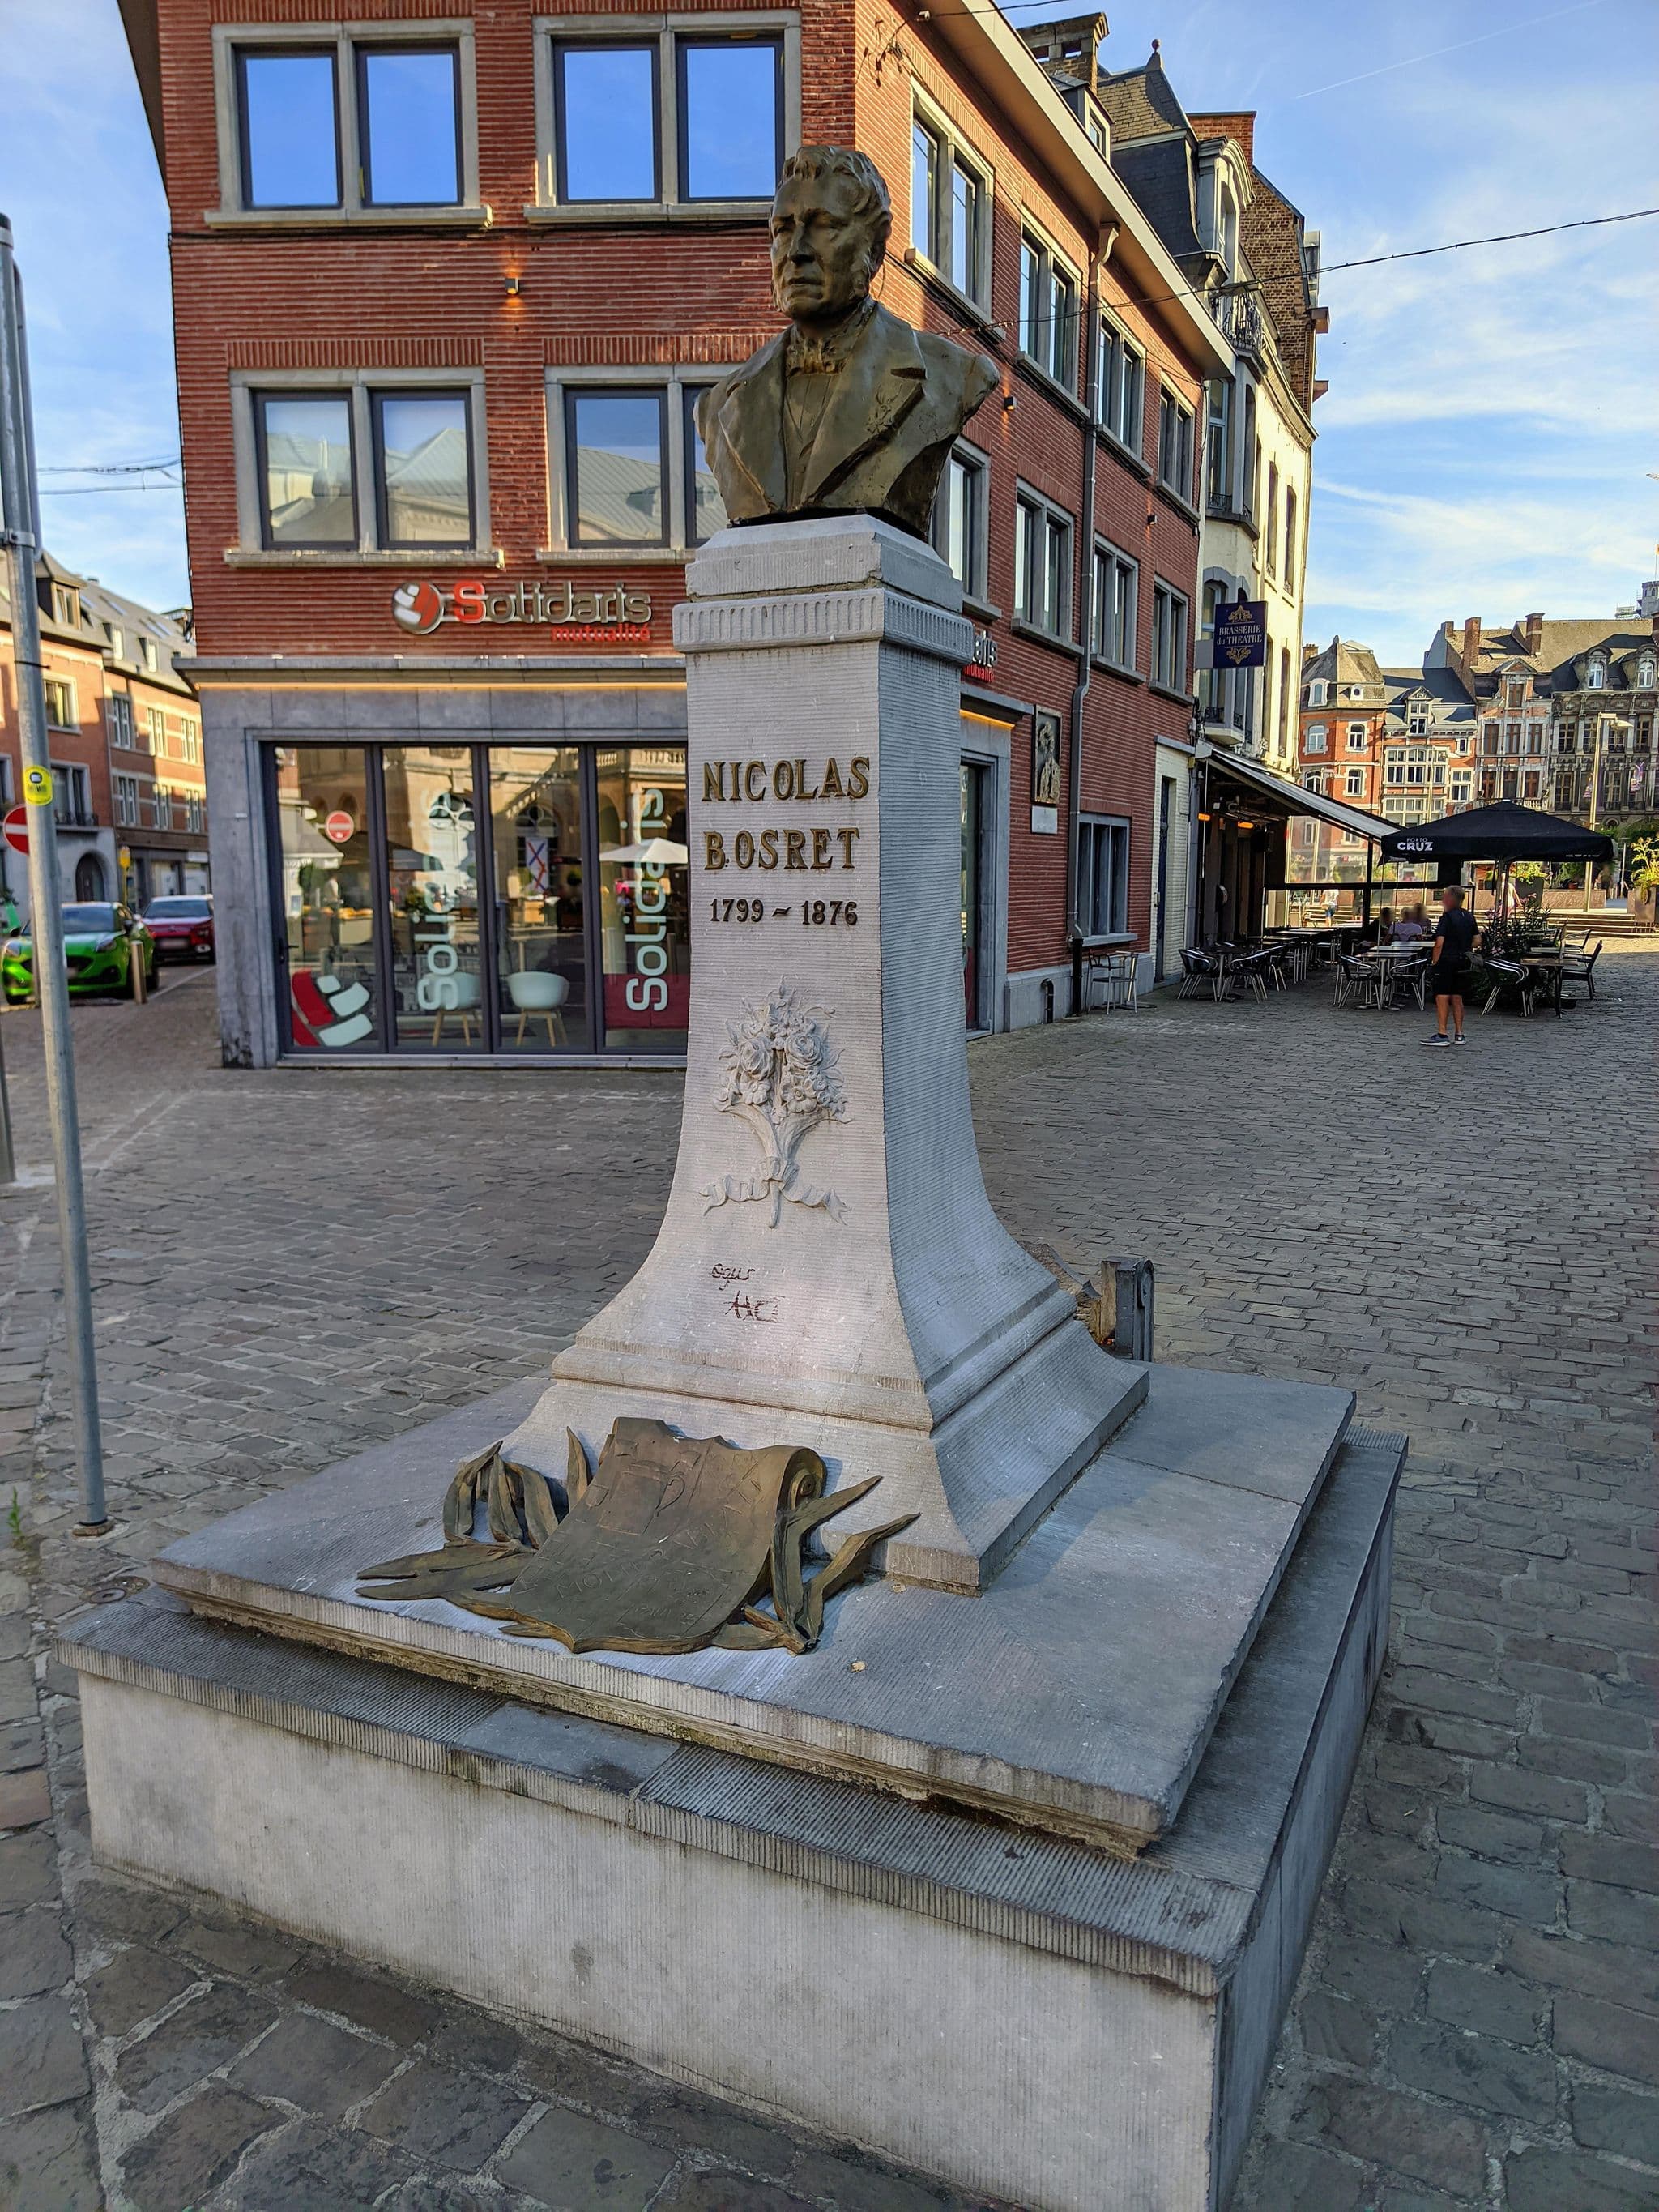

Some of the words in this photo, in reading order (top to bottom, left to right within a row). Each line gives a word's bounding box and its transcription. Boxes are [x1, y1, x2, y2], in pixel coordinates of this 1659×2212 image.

[453, 581, 651, 624] Solidaris
[551, 624, 650, 642] mutualité
[1217, 637, 1225, 645] du
[1226, 634, 1262, 645] THEATRE
[1219, 625, 1261, 635] BRASSERIE
[702, 756, 870, 802] NICOLAS
[703, 827, 861, 870] BOSRET
[1397, 841, 1433, 851] CRUZ
[620, 788, 668, 1011] Solidais
[710, 898, 764, 922] 1799
[800, 900, 858, 925] 1876
